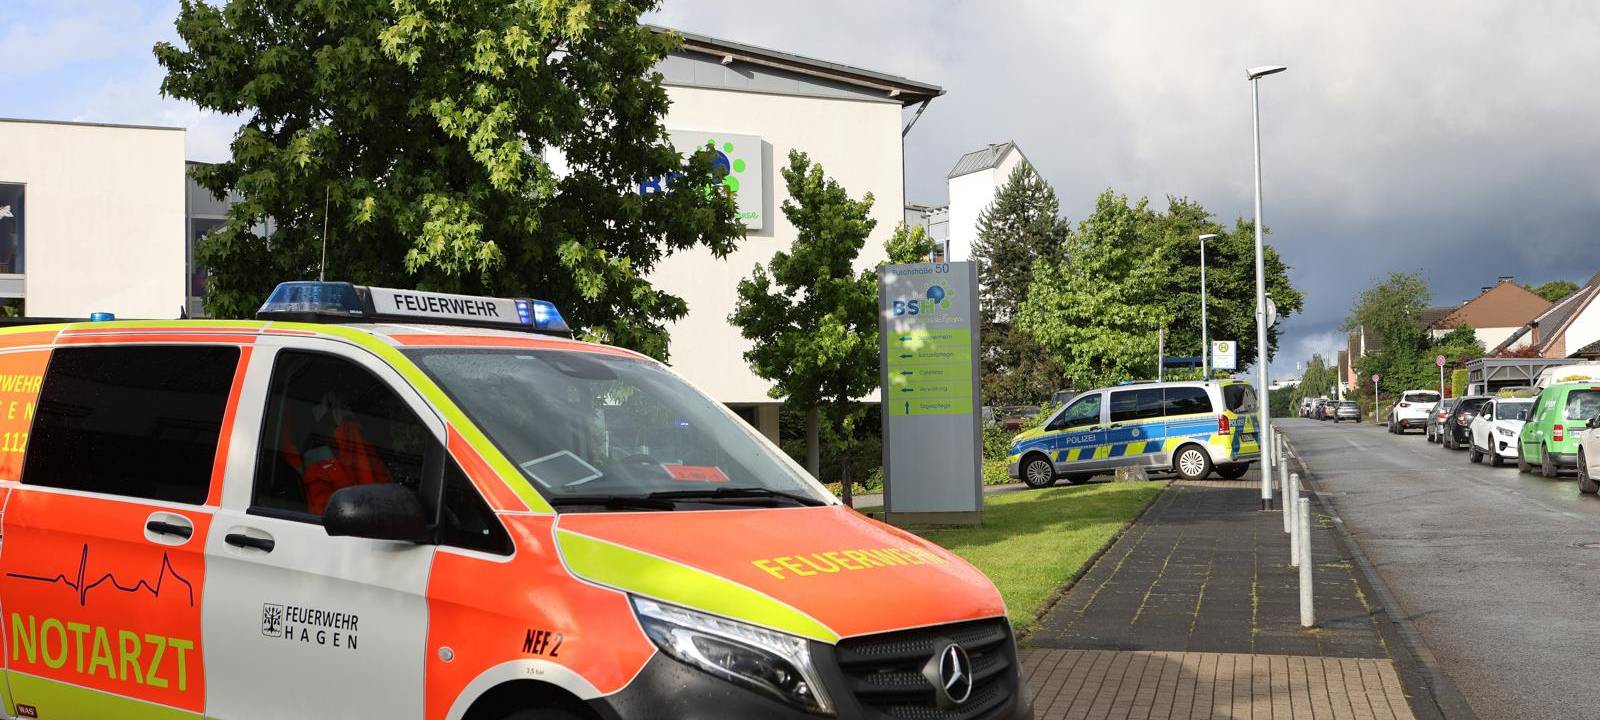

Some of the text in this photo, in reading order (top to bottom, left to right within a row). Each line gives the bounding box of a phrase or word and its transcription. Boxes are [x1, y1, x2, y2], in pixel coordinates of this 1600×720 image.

[935, 263, 950, 274] 50
[393, 294, 499, 317] FEUERWEHR
[892, 299, 935, 316] BSH
[0, 374, 43, 393] WEHR
[2, 431, 28, 453] 112
[1066, 434, 1096, 444] POLIZEI
[286, 606, 359, 631] FEUERWEHR
[11, 612, 194, 692] NOTARZT
[522, 629, 563, 657] NEF 2
[18, 706, 35, 715] WAS
